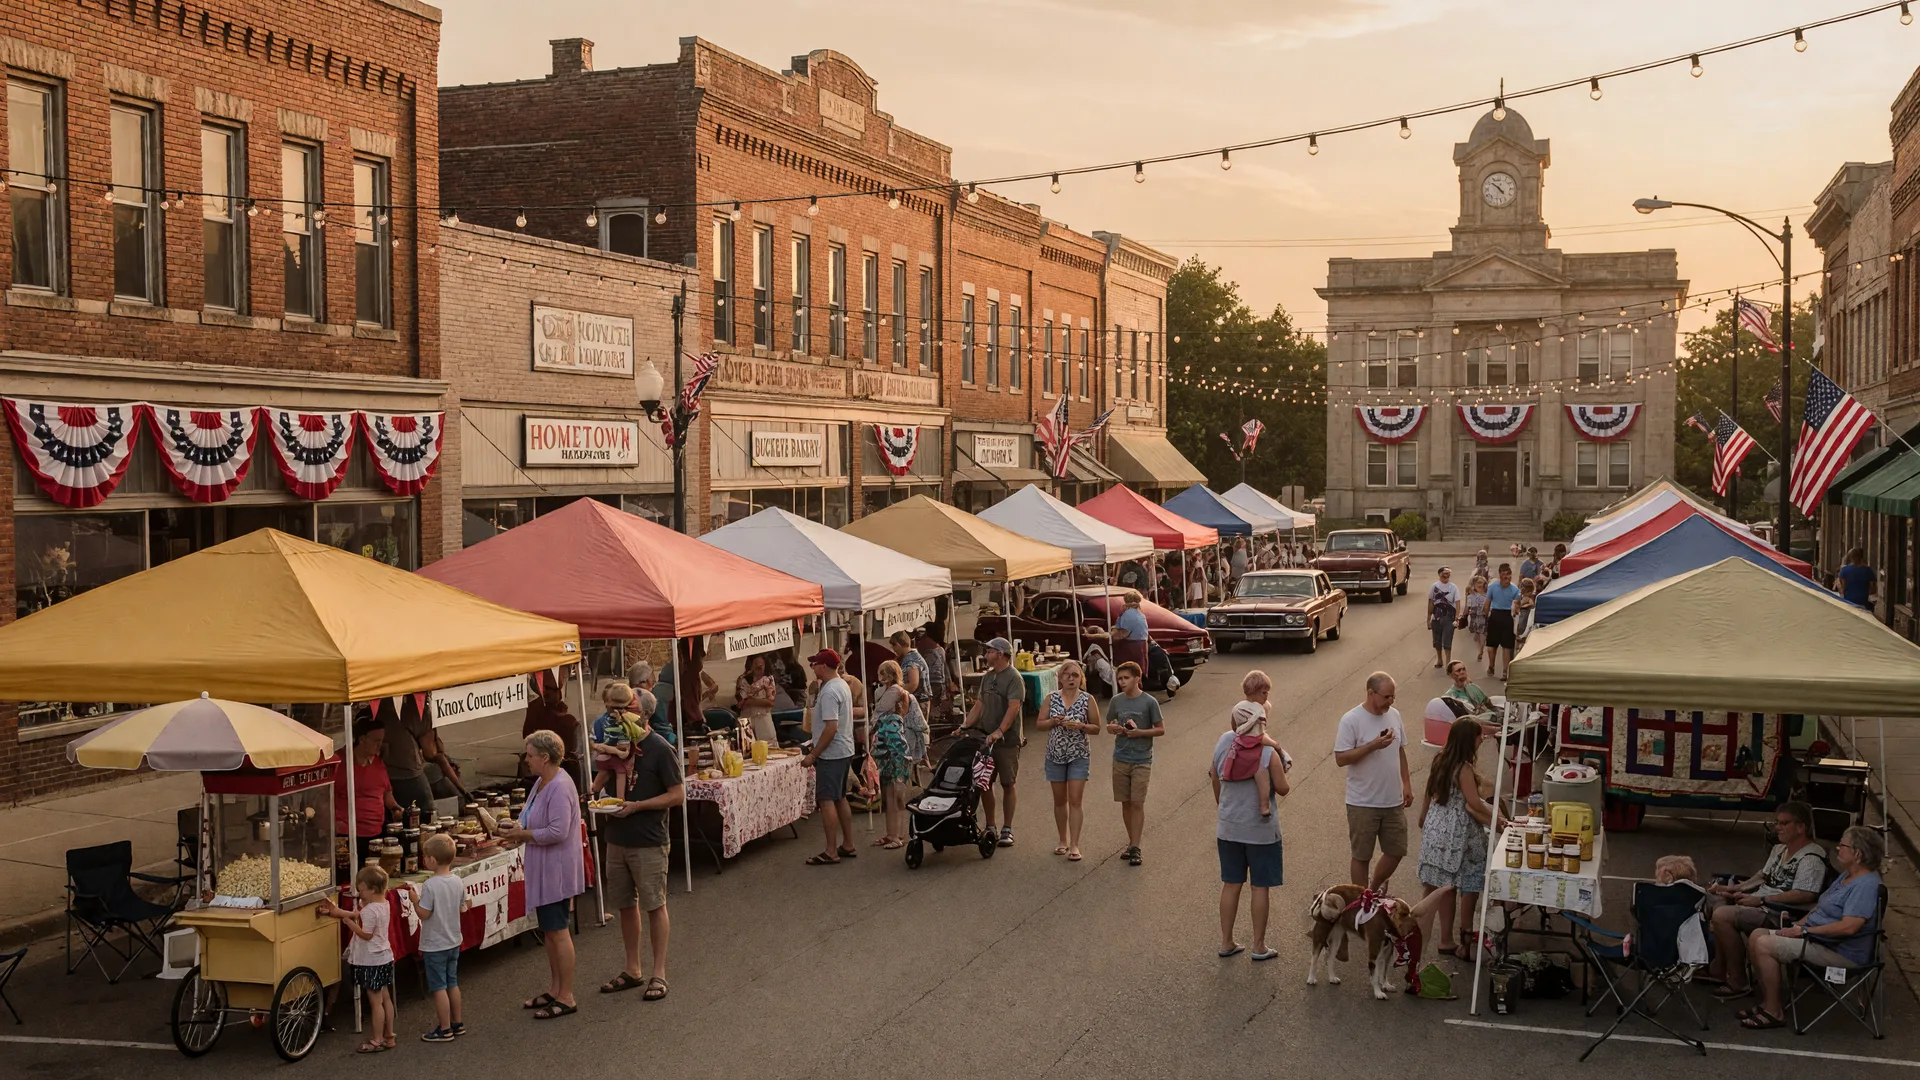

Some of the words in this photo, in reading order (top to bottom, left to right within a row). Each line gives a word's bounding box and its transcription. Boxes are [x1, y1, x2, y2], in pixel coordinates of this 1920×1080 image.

[530, 424, 630, 452] HOMETOWN
[755, 437, 789, 458] BUCKEYE
[791, 438, 819, 458] BAKERY
[728, 636, 750, 652] Knox
[436, 698, 465, 719] Knox
[466, 692, 504, 710] County
[506, 682, 524, 703] 4-H
